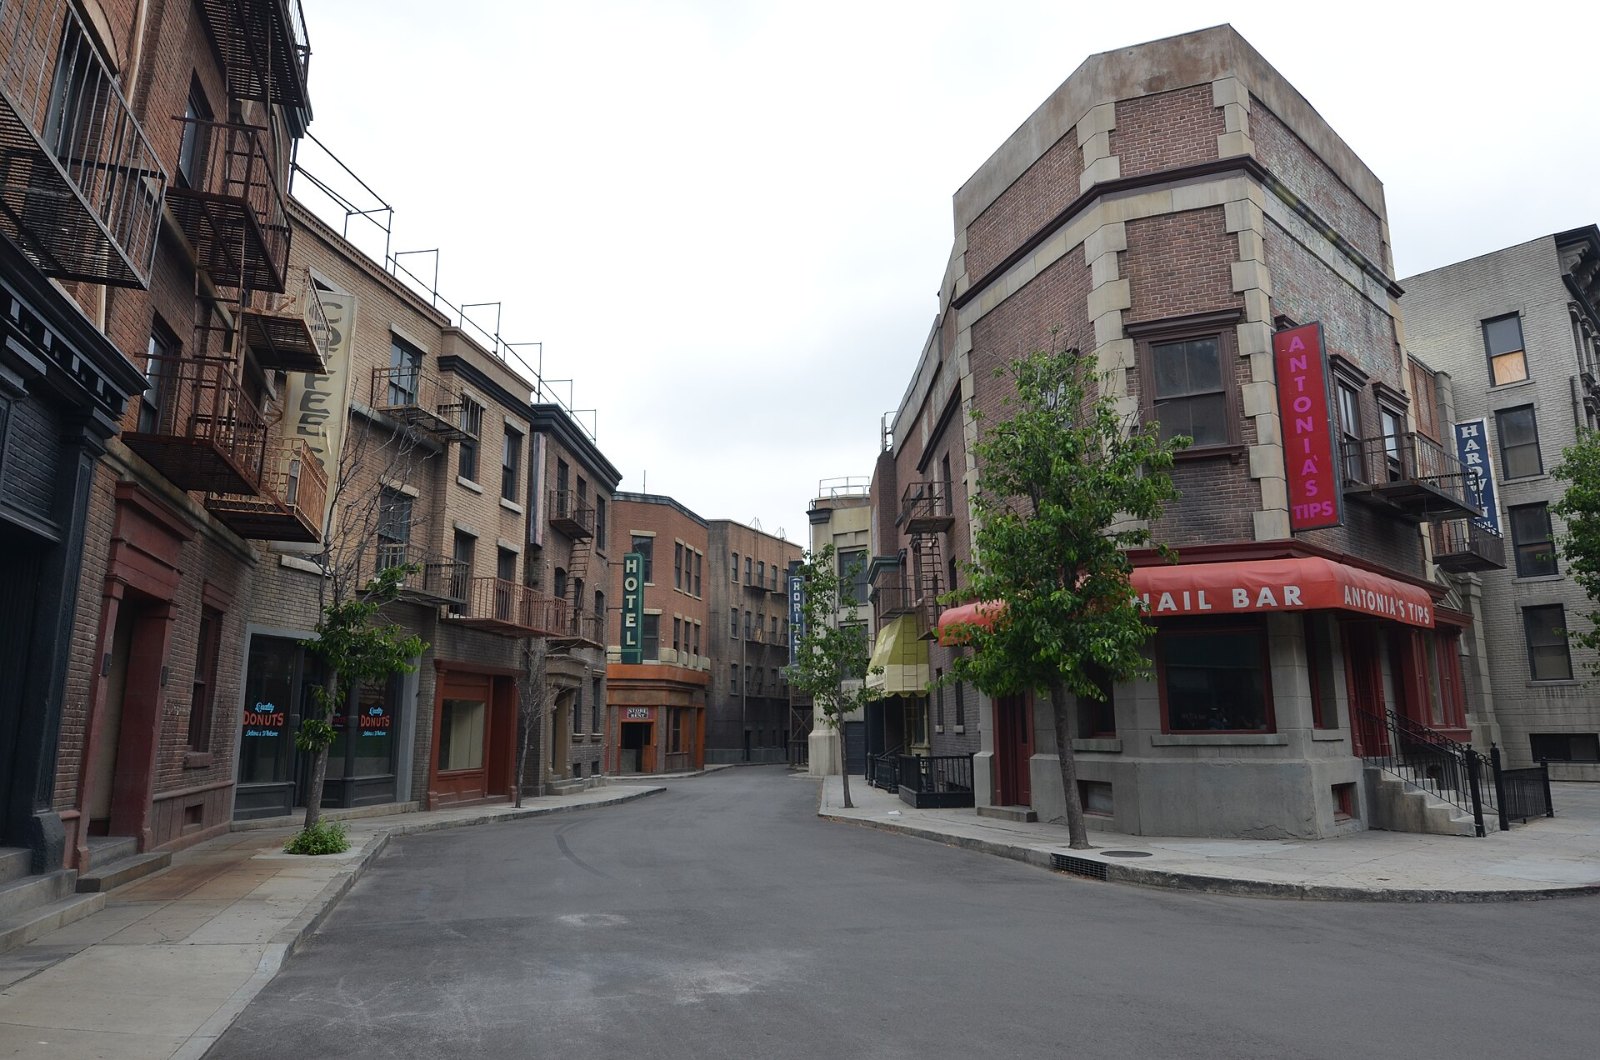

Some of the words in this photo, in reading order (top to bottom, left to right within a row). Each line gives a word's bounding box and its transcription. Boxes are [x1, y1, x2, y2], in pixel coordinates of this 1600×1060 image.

[1289, 336, 1319, 497] ANTONIA'S
[1293, 501, 1334, 520] TIPS
[625, 560, 638, 645] HOTEL
[1130, 590, 1211, 613] NAIL
[1232, 586, 1303, 608] BAR
[1344, 585, 1405, 618] ANTONIA'S
[1408, 603, 1430, 625] TIPS
[243, 710, 284, 726] DONUTS
[360, 715, 390, 727] DONUTS
